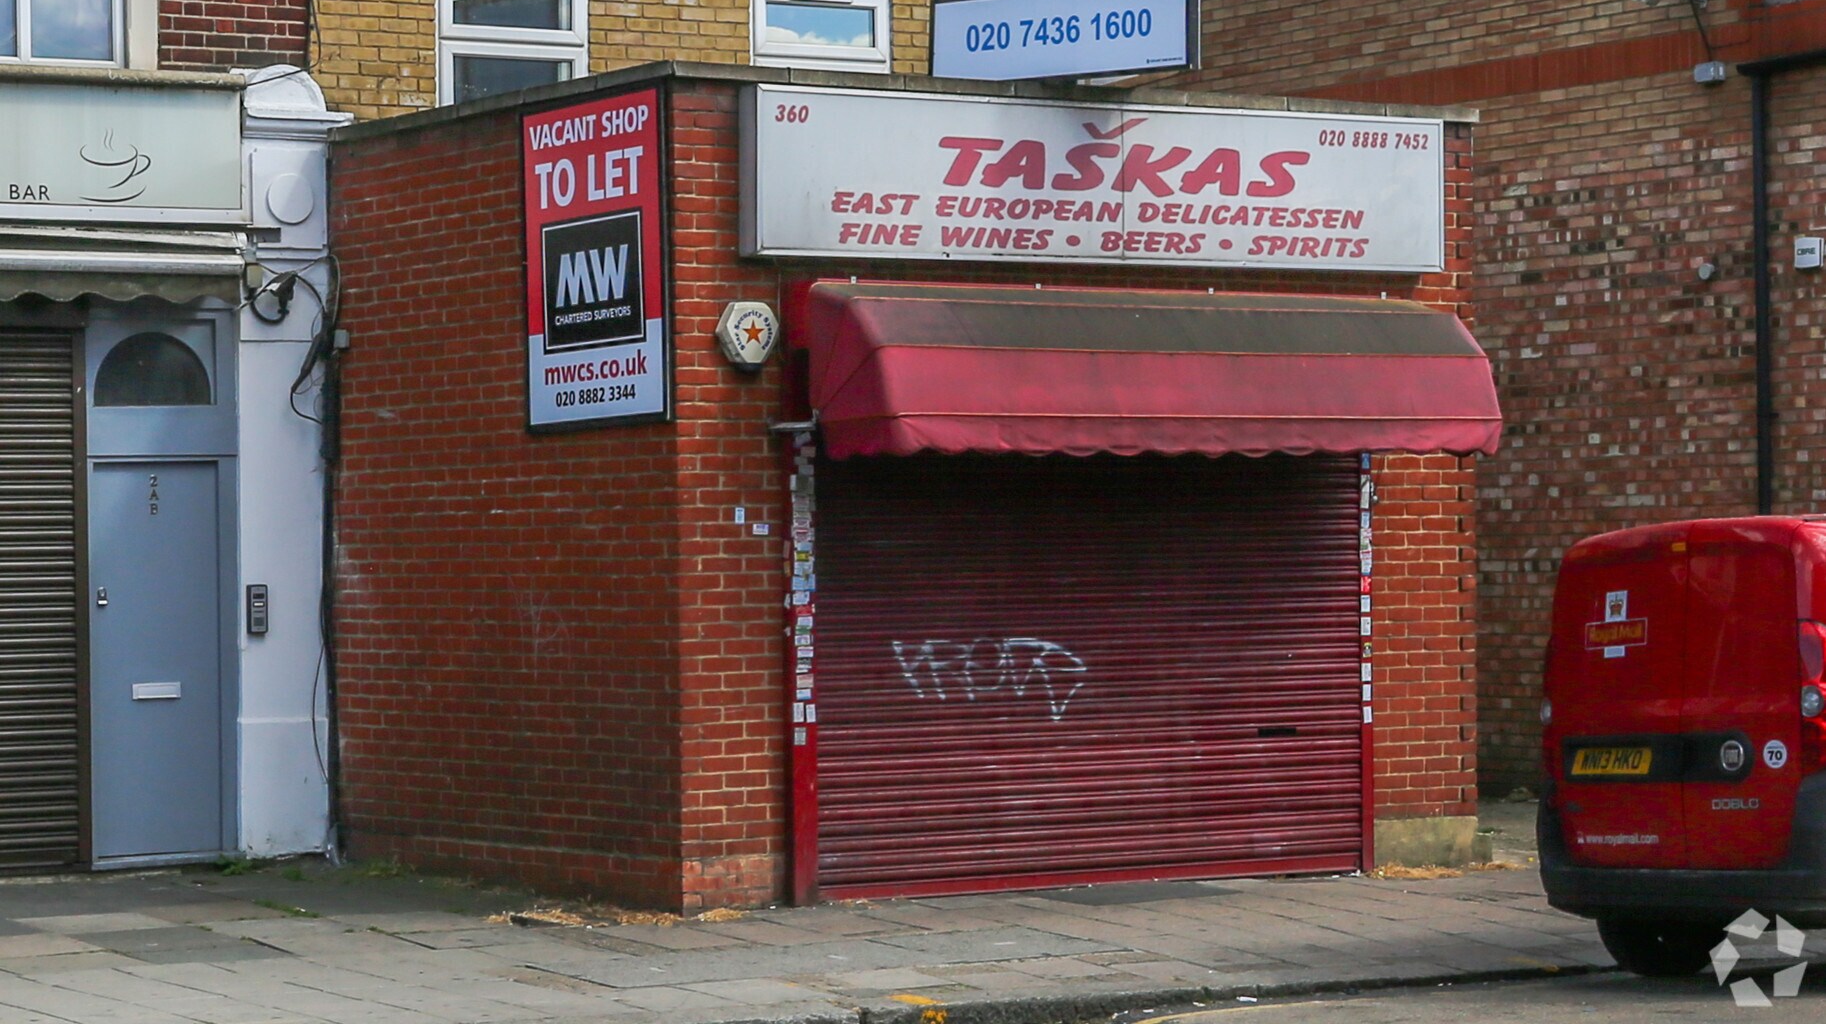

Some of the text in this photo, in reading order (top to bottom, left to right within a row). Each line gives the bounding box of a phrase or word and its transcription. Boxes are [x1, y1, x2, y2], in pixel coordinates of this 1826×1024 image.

[966, 8, 1152, 52] 020 7436 1600
[529, 104, 649, 151] VACANT SHOP
[775, 104, 809, 123] 360
[938, 118, 1310, 197] TAŠKAS
[1319, 129, 1429, 150] 020 8888 7452
[9, 184, 50, 201] BAR
[535, 145, 643, 210] TO LET
[831, 191, 1364, 230] EAST EUROPEAN DELICATESSEN
[838, 223, 1369, 259] FINE WINES BEERS SPIRITS
[556, 243, 629, 308] MW
[555, 305, 631, 326] CHARTERED SURVEYORS
[734, 309, 763, 330] Security
[544, 348, 647, 386] mwcs.co.uk
[555, 383, 636, 407] 020 8882 3344
[1767, 750, 1783, 761] 70
